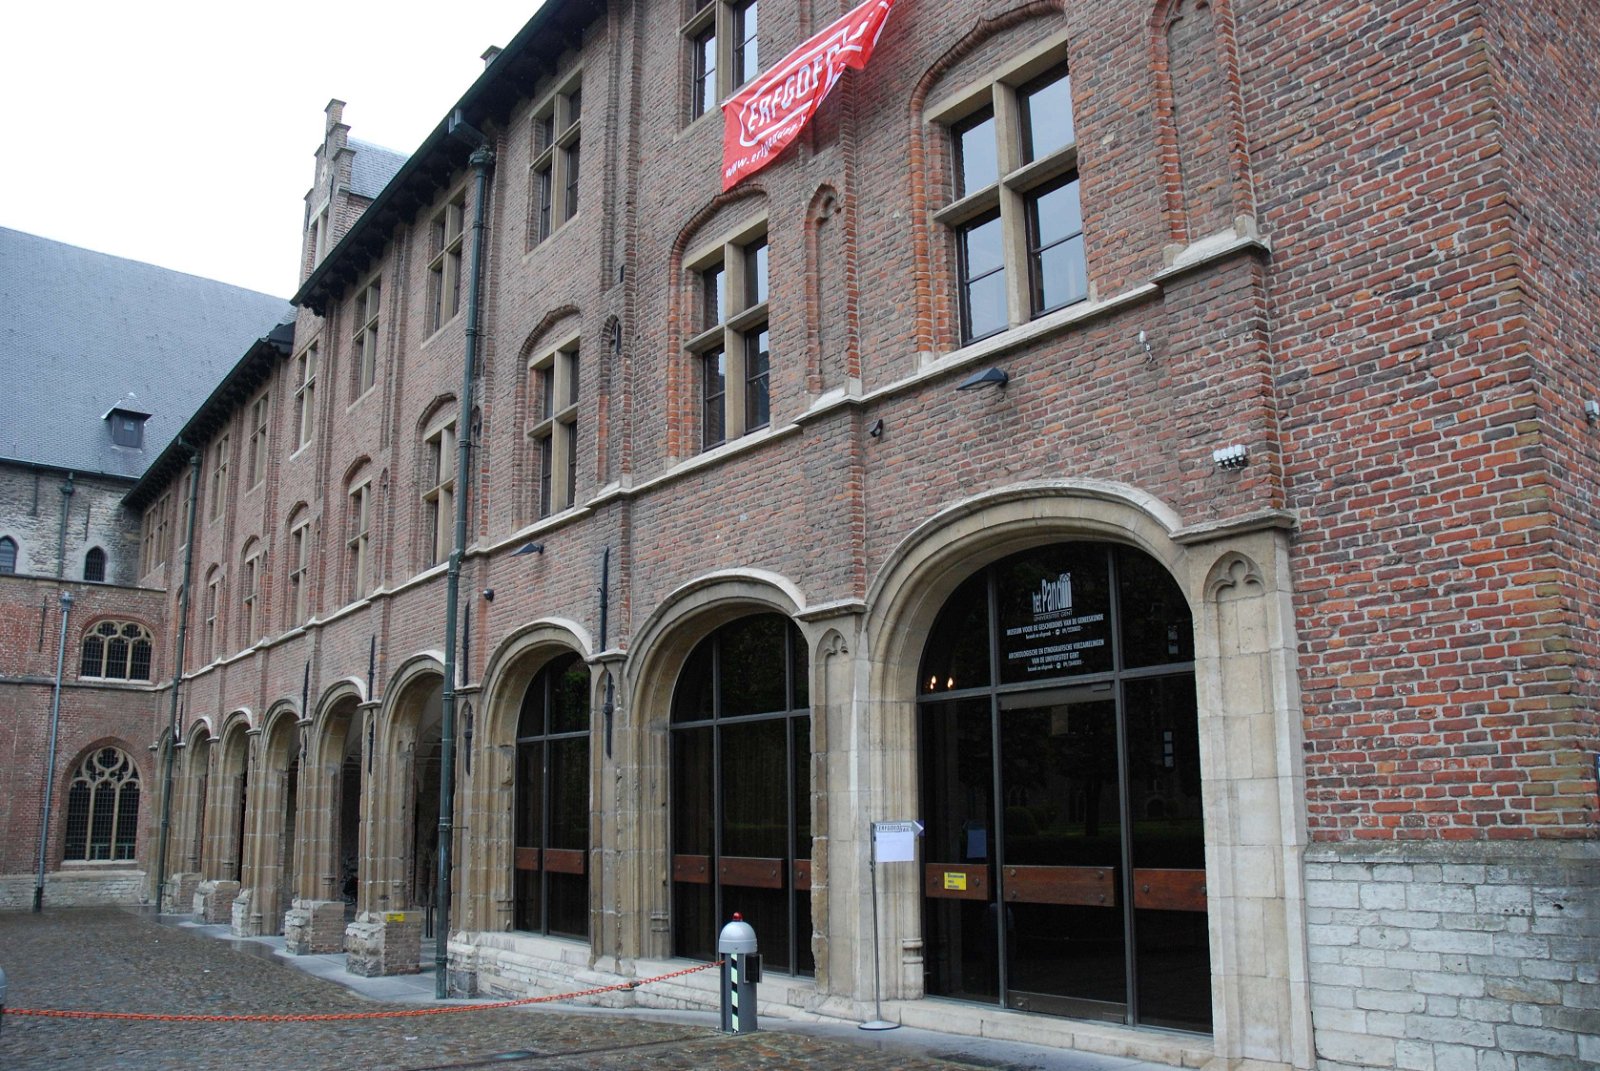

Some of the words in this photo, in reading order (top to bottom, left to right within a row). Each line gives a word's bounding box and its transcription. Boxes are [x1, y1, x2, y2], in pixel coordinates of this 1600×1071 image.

[1032, 591, 1042, 613] het
[1042, 572, 1072, 612] Pand
[1007, 628, 1022, 636] MUSEUM
[1022, 625, 1033, 633] VOOR
[1038, 621, 1063, 631] GESCHIEDENIS
[1063, 619, 1072, 627] VAN
[1077, 614, 1104, 624] GENEESKUNDE
[1038, 647, 1044, 655] EN
[1073, 639, 1104, 649] VERZAMELINGEN
[1069, 651, 1079, 659] GENT
